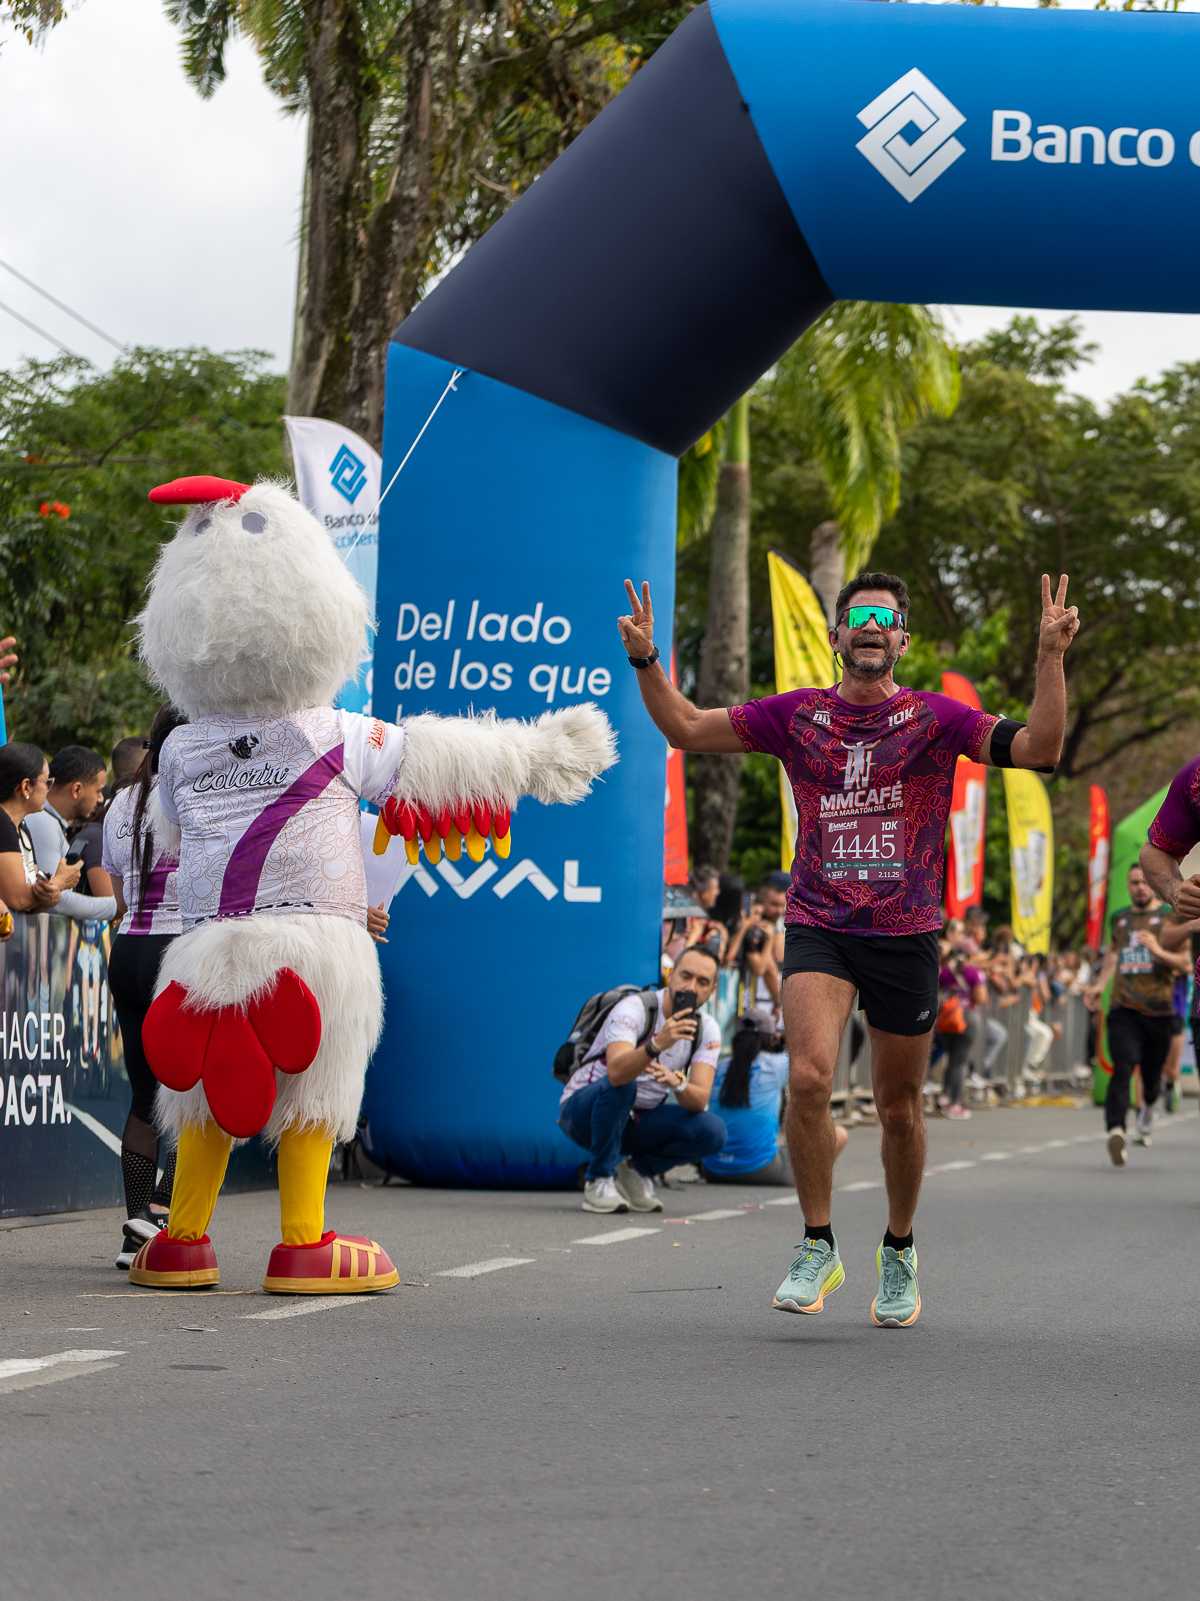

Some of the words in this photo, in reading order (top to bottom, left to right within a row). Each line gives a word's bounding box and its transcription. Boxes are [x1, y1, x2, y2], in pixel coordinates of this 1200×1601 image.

[991, 109, 1175, 167] Banco
[396, 600, 456, 641] Del
[466, 600, 572, 644] lado
[394, 649, 436, 690] de
[448, 649, 513, 691] los
[528, 664, 612, 703] que
[888, 706, 915, 727] 10K
[819, 781, 904, 812] MMCAFÉ
[881, 820, 898, 831] 10K
[831, 834, 896, 859] 4445
[396, 857, 602, 903] AVAL
